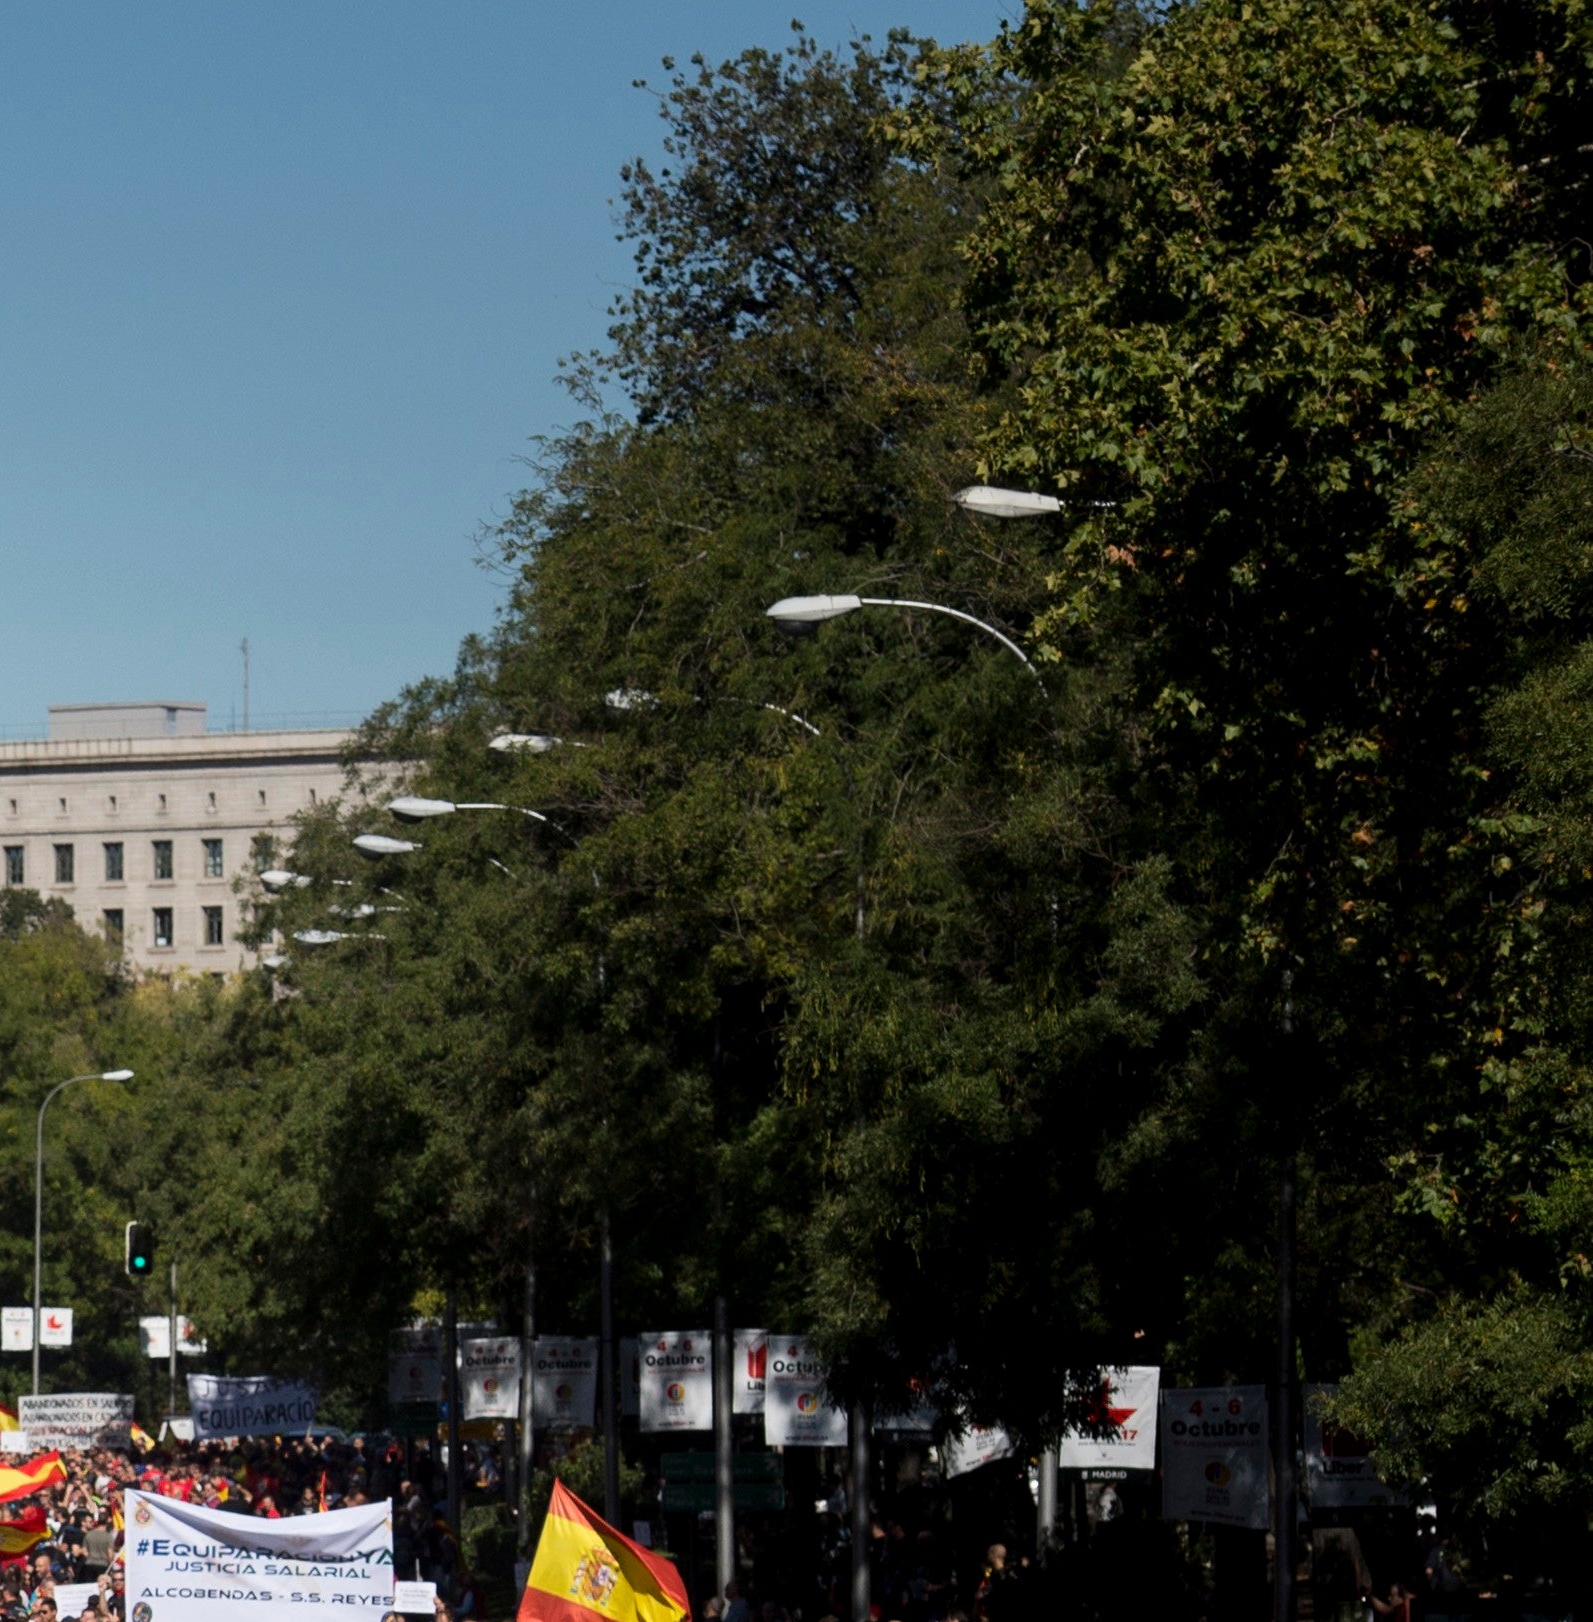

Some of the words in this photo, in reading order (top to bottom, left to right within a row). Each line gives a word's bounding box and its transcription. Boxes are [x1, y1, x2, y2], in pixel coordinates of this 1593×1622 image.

[466, 1354, 515, 1368] Octubre
[537, 1357, 593, 1371] Octubre
[644, 1353, 706, 1367] Octubre
[1189, 1400, 1204, 1417] 4
[1227, 1398, 1242, 1416] 6
[1171, 1418, 1261, 1438] Octubre
[1092, 1470, 1128, 1480] MADRID
[164, 1561, 256, 1575] JUSTICIA
[265, 1564, 371, 1579] SALARIAL
[141, 1587, 272, 1601] ALCOBENDAS
[291, 1592, 325, 1604] S.S.
[331, 1594, 394, 1606] REYES
